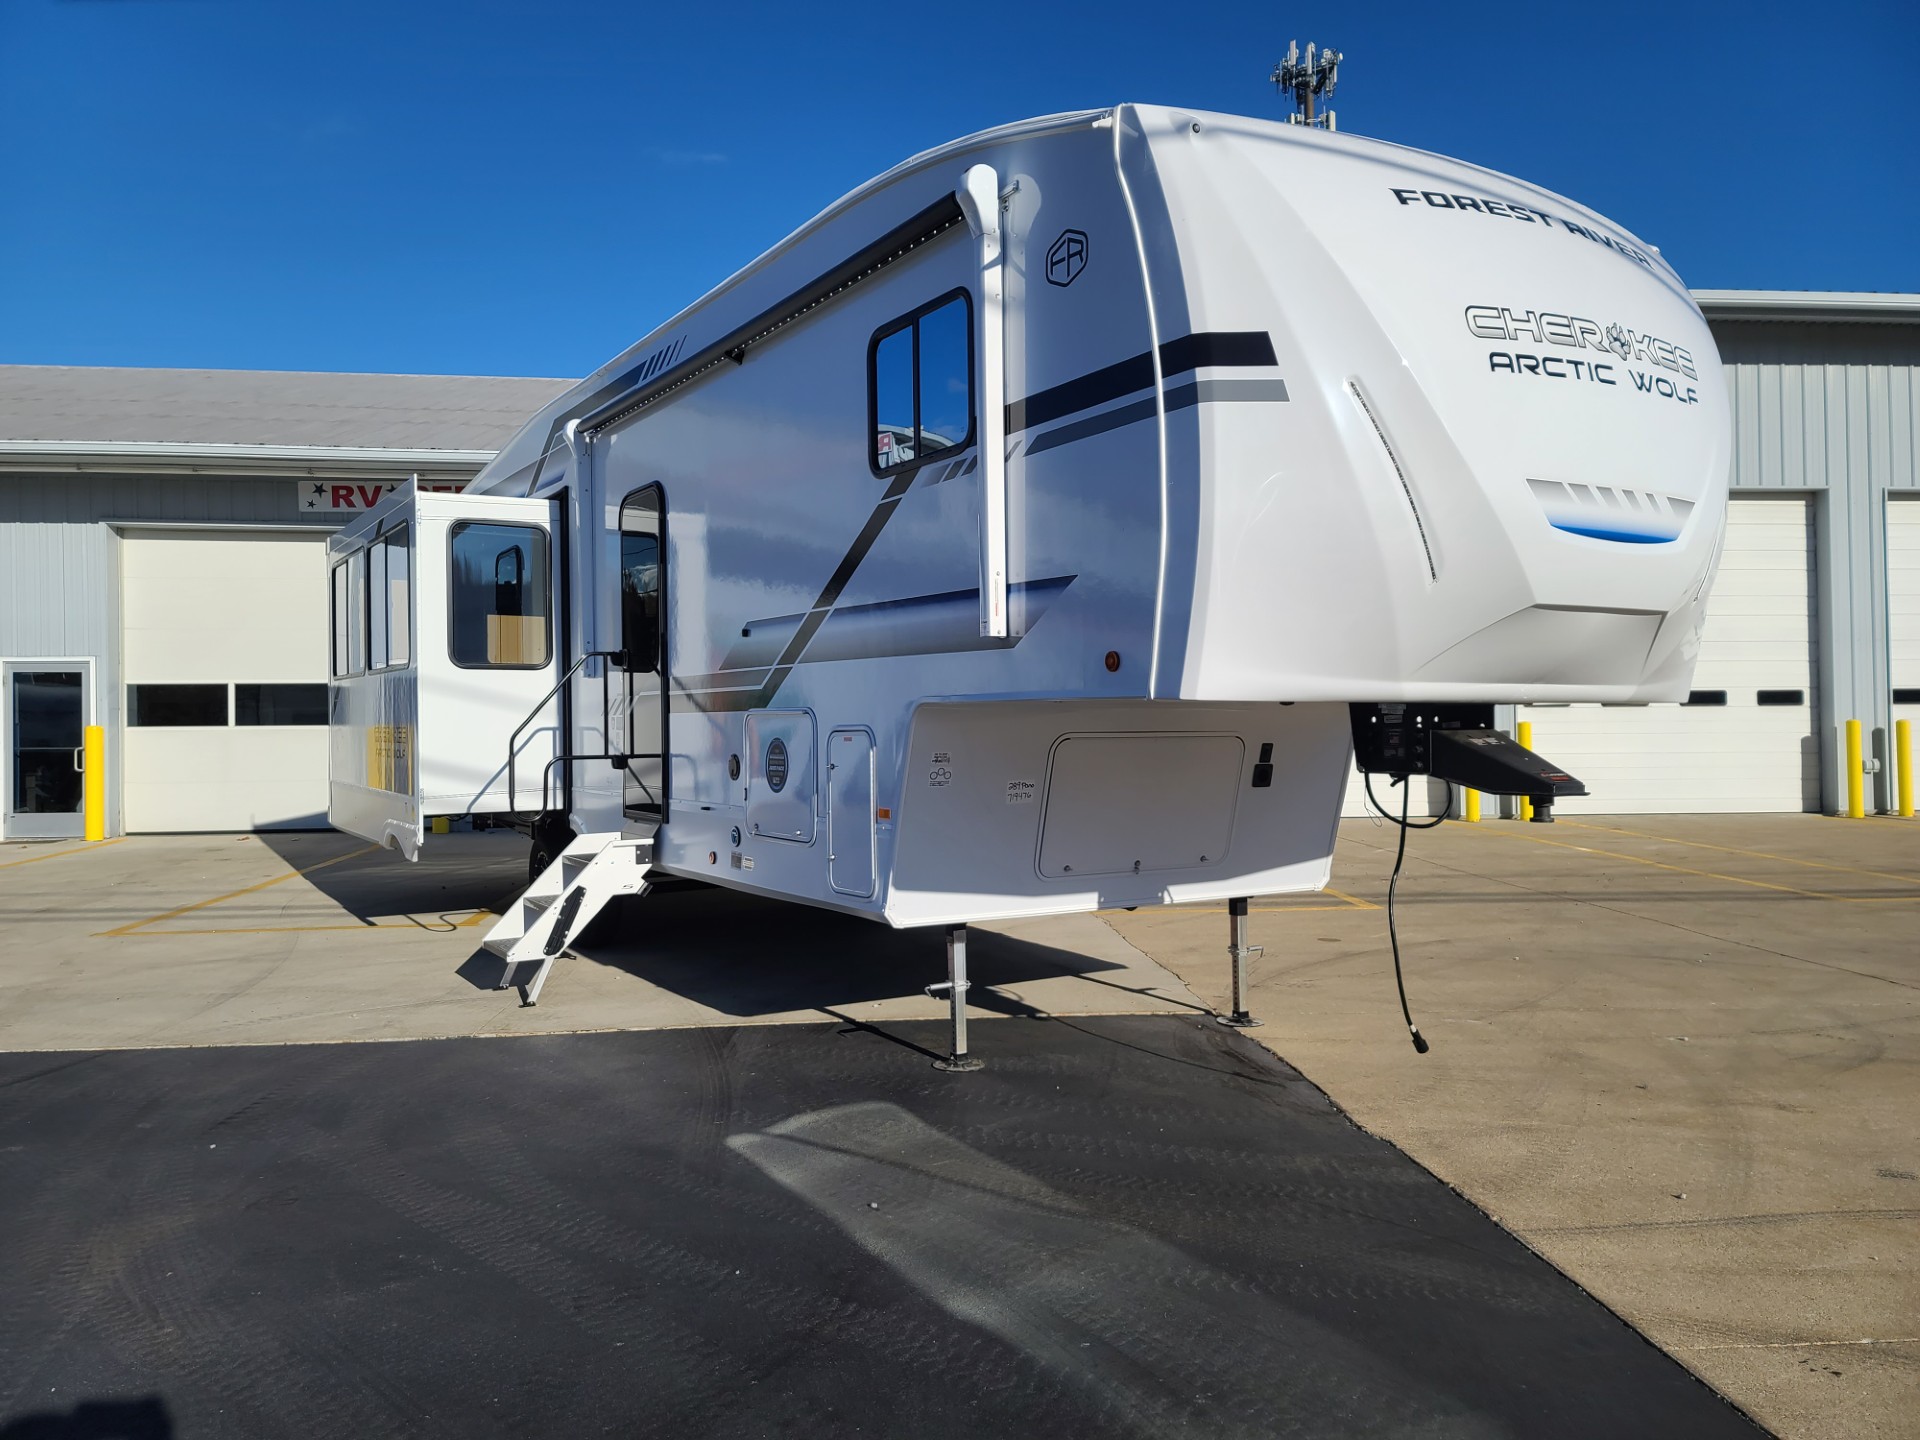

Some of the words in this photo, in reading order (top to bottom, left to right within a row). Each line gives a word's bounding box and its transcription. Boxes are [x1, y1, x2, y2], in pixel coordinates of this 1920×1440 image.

[1388, 187, 1553, 228] FOREST
[1560, 218, 1656, 271] RIVER
[1489, 351, 1617, 386] ARCTIC
[1627, 368, 1699, 405] WOLF
[330, 484, 383, 508] RV
